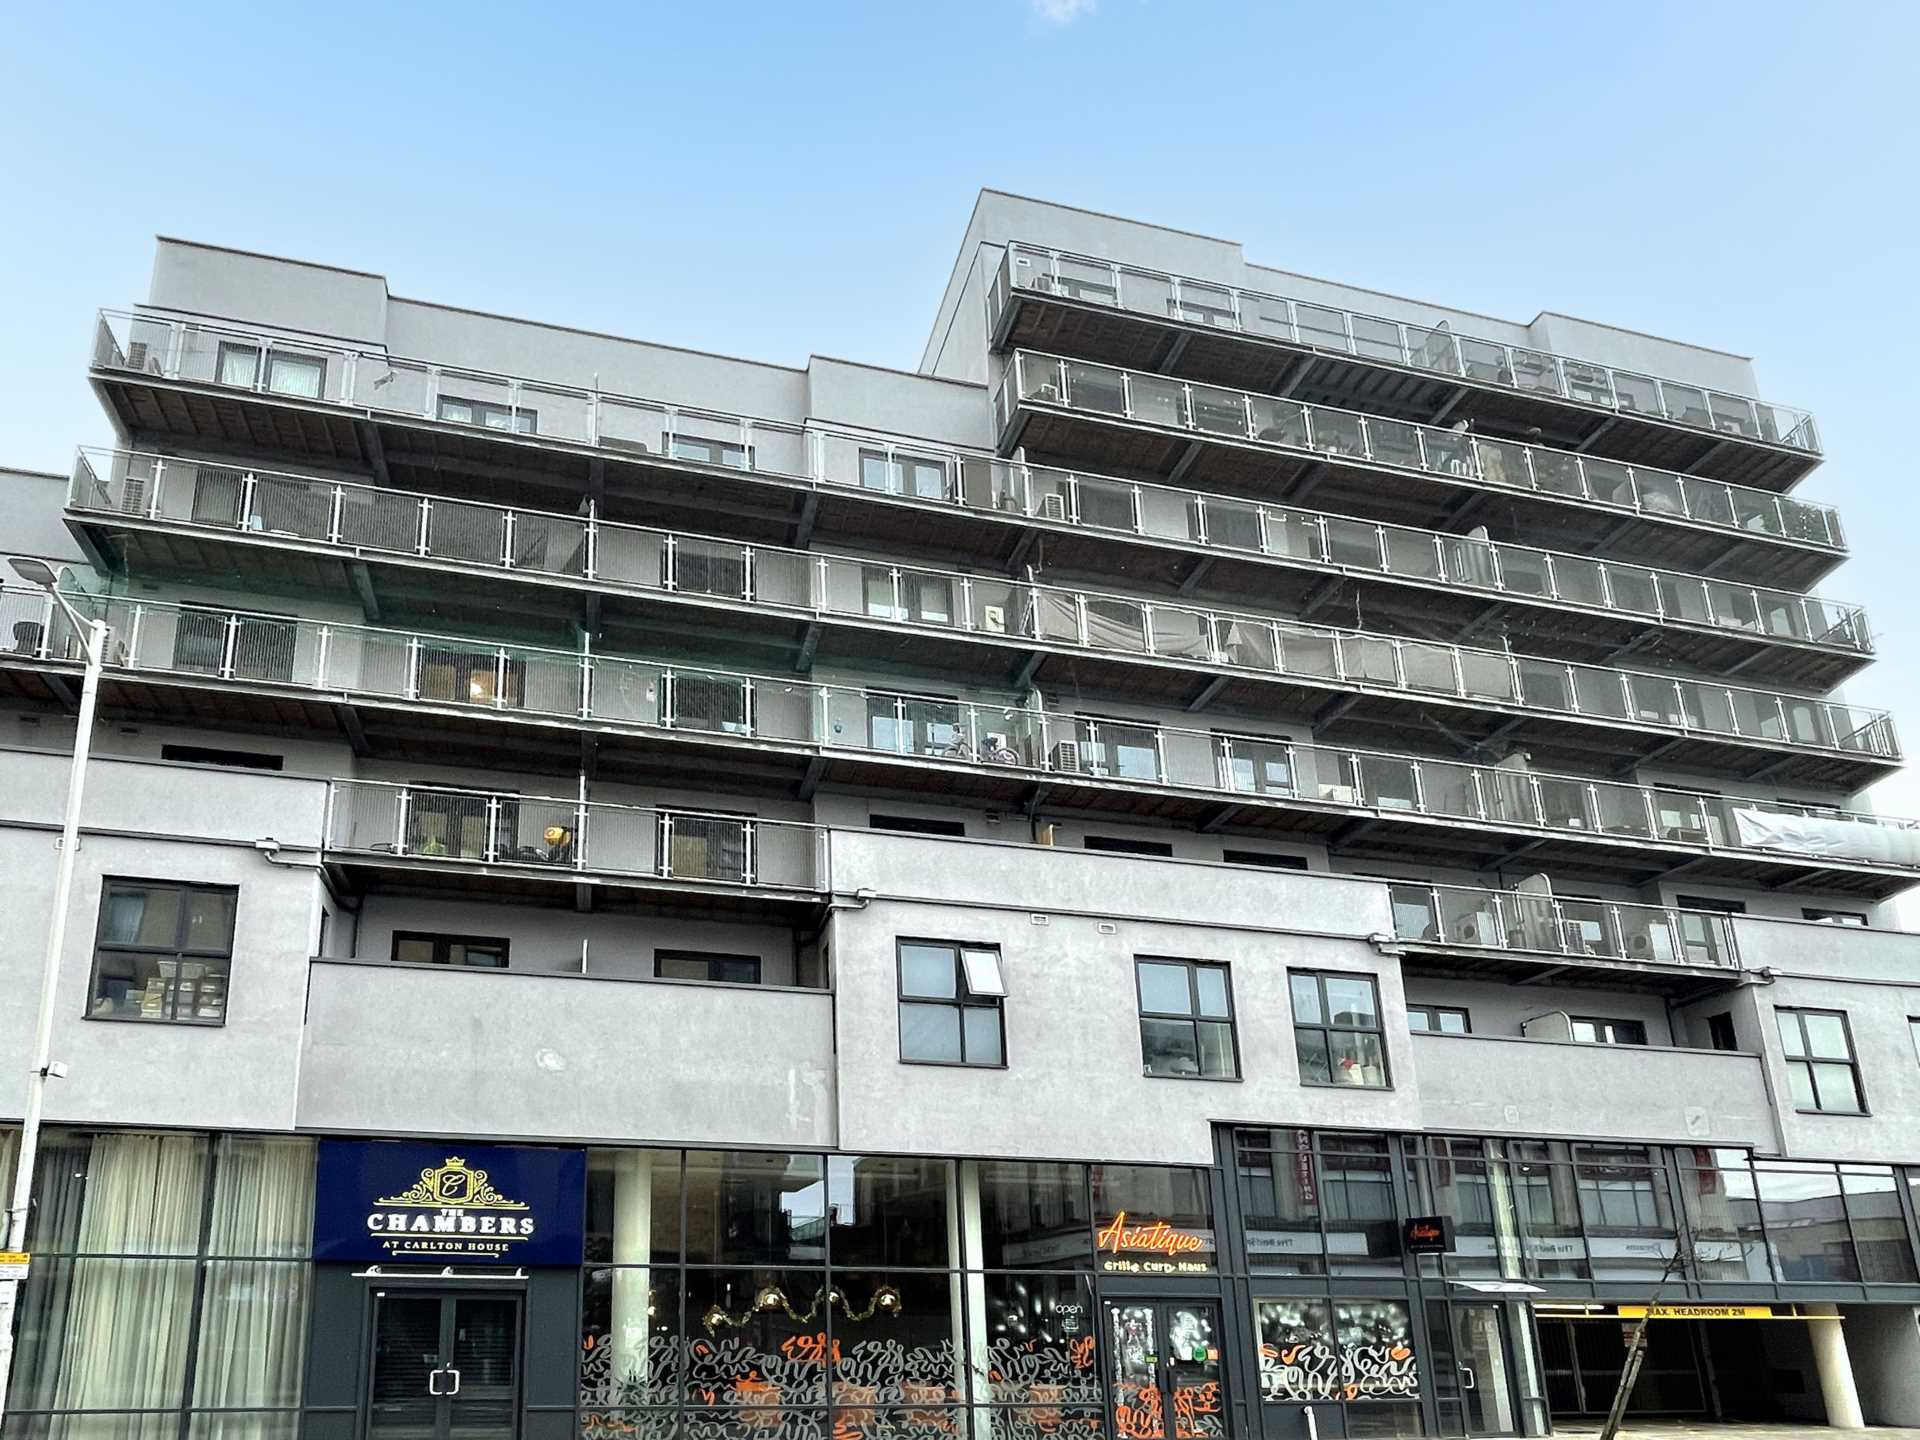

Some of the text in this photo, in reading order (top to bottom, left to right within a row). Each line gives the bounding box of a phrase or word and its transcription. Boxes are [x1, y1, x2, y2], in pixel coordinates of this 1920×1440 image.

[367, 1213, 534, 1234] CHAMBERS
[1098, 1210, 1204, 1257] Asiatique
[382, 1240, 509, 1252] AT CARLTON HOUSE
[1178, 1261, 1208, 1272] Haus
[1055, 1304, 1084, 1316] open
[1673, 1306, 1729, 1317] HEADROOM
[1731, 1307, 1746, 1317] 2M
